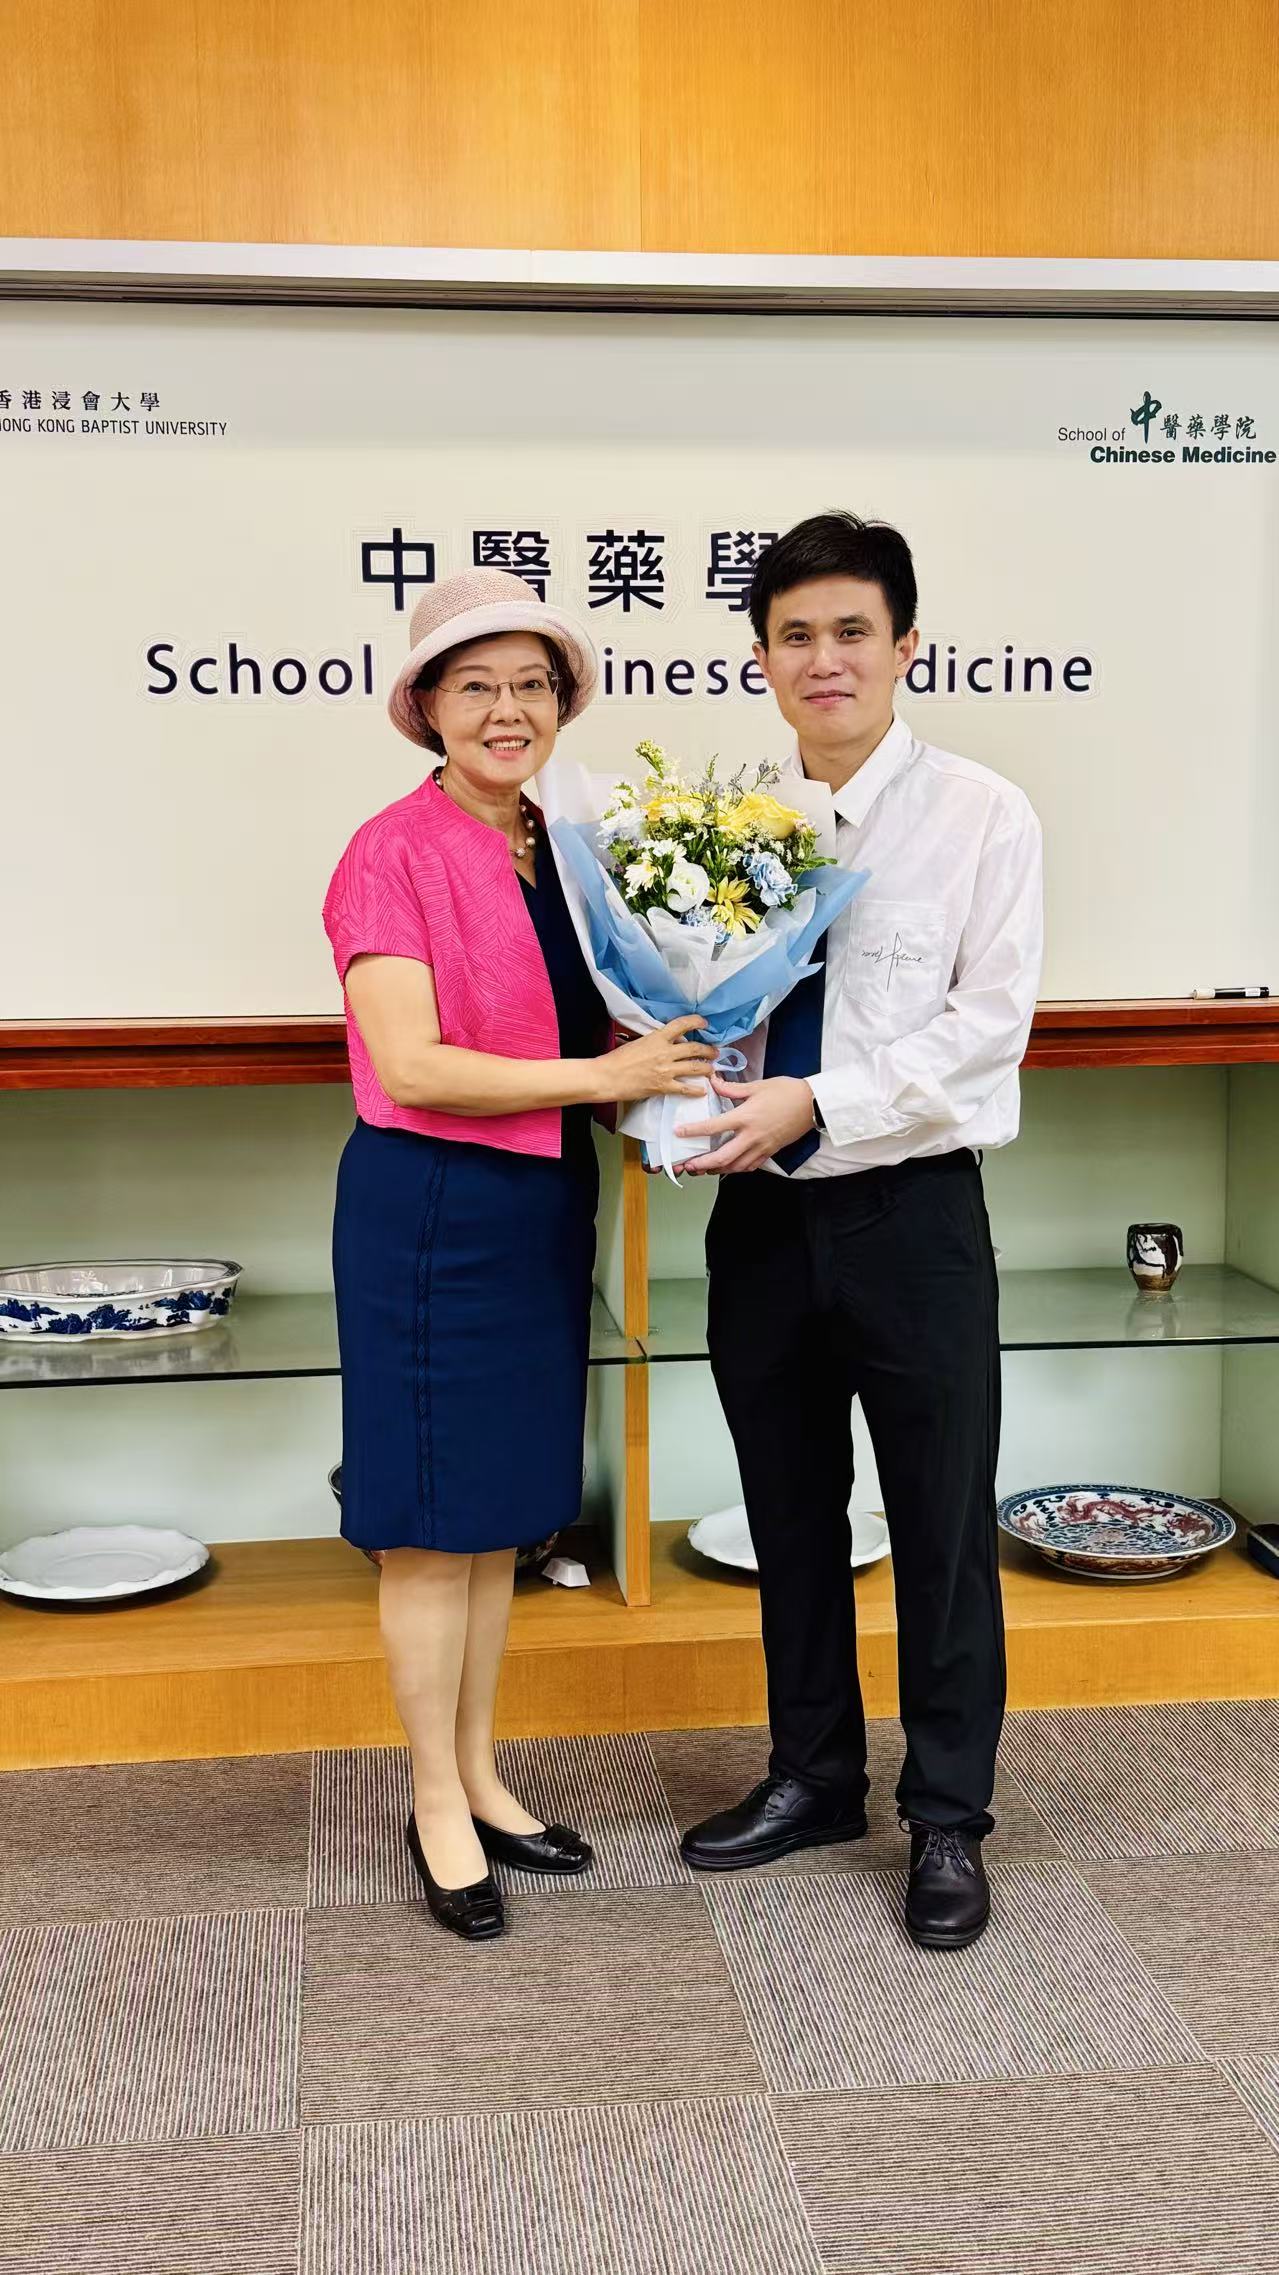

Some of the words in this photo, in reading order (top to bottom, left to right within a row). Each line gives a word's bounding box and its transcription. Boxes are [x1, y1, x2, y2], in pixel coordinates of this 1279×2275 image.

[0, 389, 161, 412] 香港浸會大學
[0, 418, 32, 433] ONG
[37, 418, 75, 433] KONG
[81, 419, 140, 434] BAPTIST
[145, 420, 227, 436] UNIVERSITY
[1129, 390, 1257, 444] 中醫藥學院
[1057, 426, 1107, 442] School
[1111, 427, 1126, 442] of
[1090, 445, 1176, 464] Chinese
[1182, 445, 1277, 464] Medicine
[361, 527, 779, 613] 中醫藥學
[146, 642, 373, 696] School
[603, 647, 767, 696] inese
[905, 643, 1093, 694] dicine
